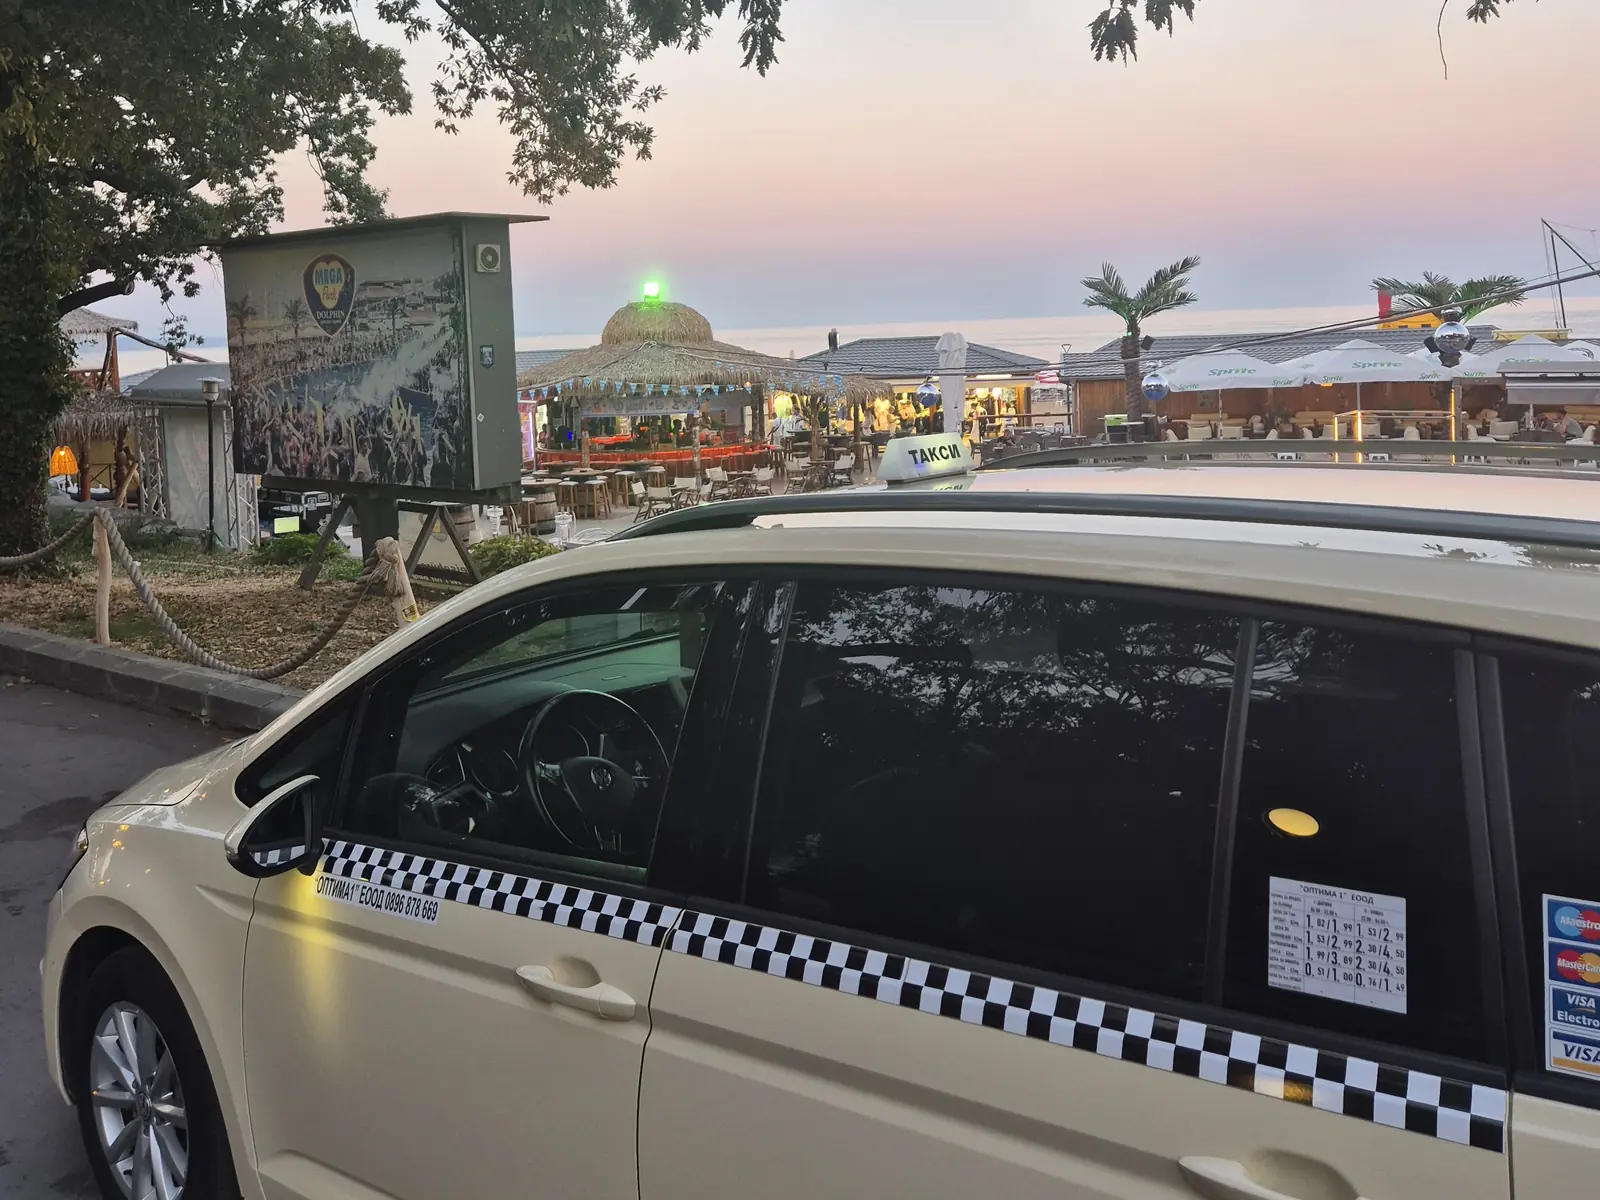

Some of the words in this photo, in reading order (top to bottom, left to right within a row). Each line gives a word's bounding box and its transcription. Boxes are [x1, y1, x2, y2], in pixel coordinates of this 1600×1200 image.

[315, 267, 343, 285] MEGA
[316, 309, 345, 320] DOLPHIN
[1208, 367, 1256, 376] Sprite
[1352, 361, 1402, 369] Sprite
[1420, 370, 1441, 380] Sprite
[908, 443, 961, 465] ТАКСИ
[358, 885, 385, 911] ЕООД
[384, 891, 406, 914] 0896
[404, 896, 422, 918] 878
[421, 899, 439, 921] 669
[1351, 893, 1374, 905] ЕООД
[1560, 915, 1600, 930] Maestro
[1566, 993, 1596, 1009] VISA
